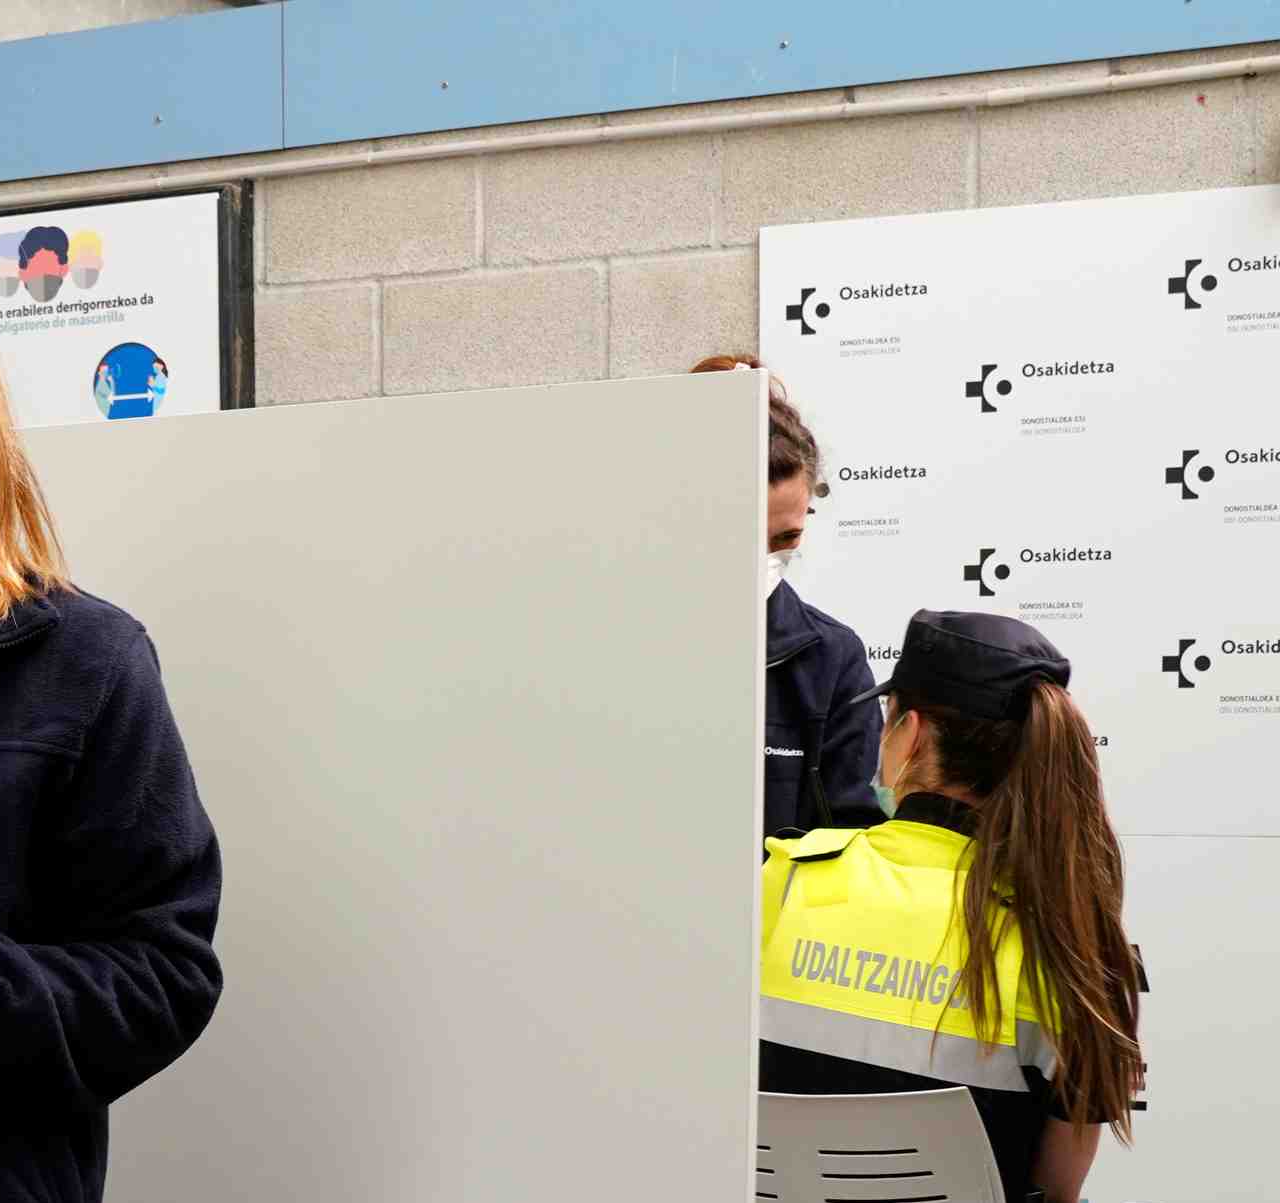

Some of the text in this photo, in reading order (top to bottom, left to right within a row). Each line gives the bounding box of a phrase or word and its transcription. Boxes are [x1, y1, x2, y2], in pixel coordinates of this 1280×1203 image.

[1228, 254, 1280, 273] Osaki
[839, 283, 928, 301] Osakidetza
[5, 302, 54, 319] erabilera
[56, 296, 137, 315] derrigorrezkoa
[139, 293, 155, 305] da
[52, 316, 66, 328] de
[1022, 360, 1115, 378] Osakidetza
[838, 465, 927, 481] Osakidetza
[1020, 547, 1112, 563] Osakidetza
[791, 939, 972, 1009] UDALTZAINGO
